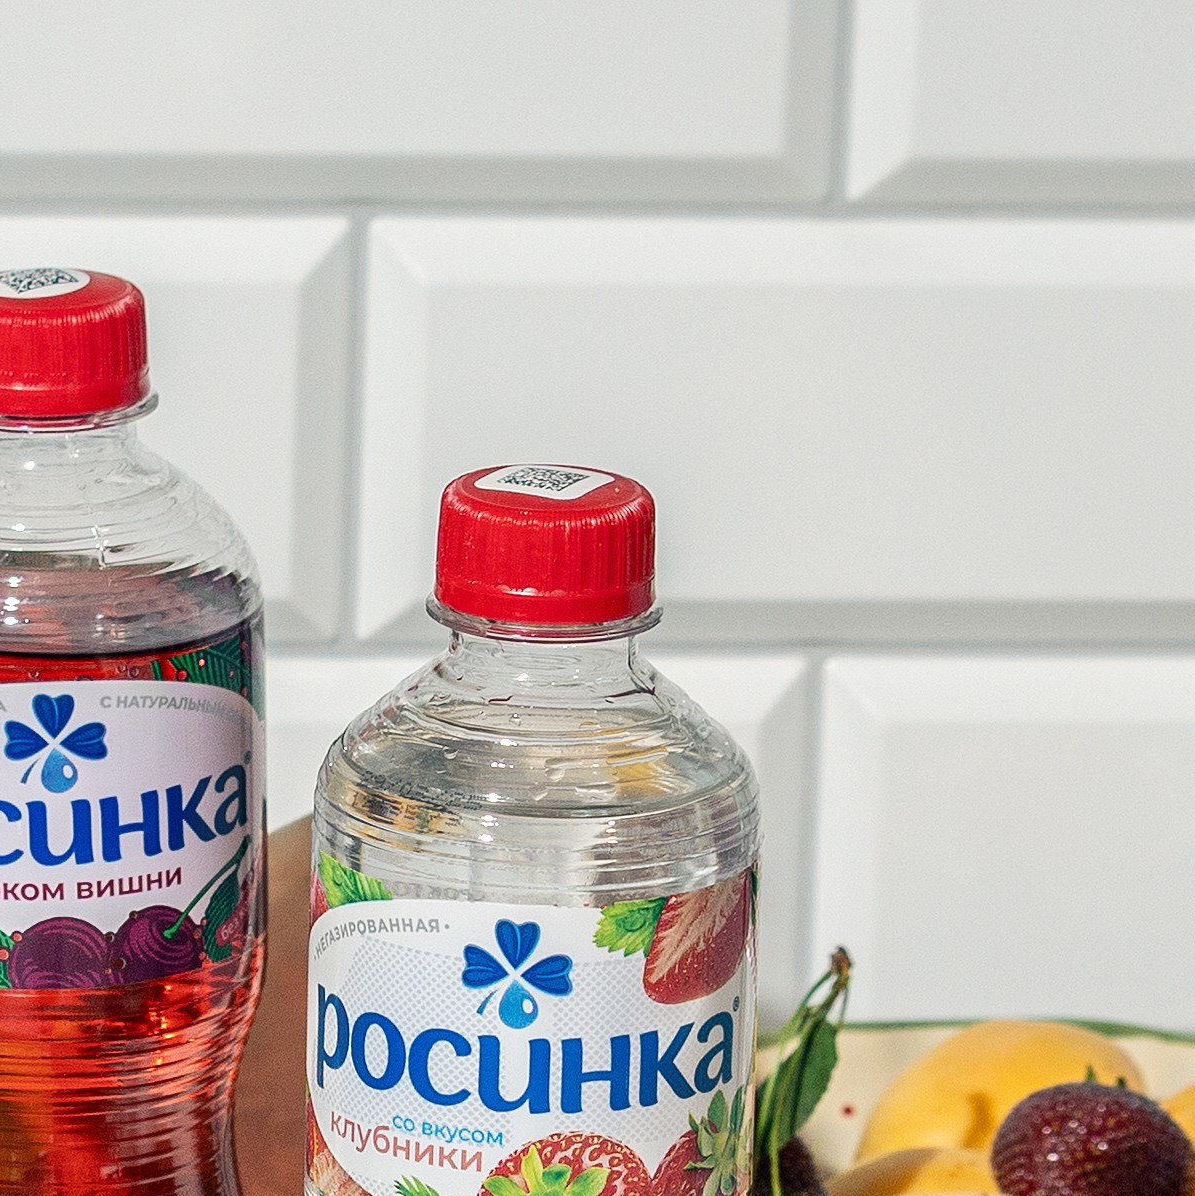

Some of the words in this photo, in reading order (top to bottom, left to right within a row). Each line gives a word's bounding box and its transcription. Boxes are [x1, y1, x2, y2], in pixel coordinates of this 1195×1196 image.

[100, 696, 112, 709] С
[315, 917, 441, 957] НЕГАЗИРОВАННАЯ
[317, 983, 734, 1115] росинка
[330, 1111, 483, 1173] клубники
[392, 1114, 416, 1132] со
[421, 1121, 503, 1145] вкусом
